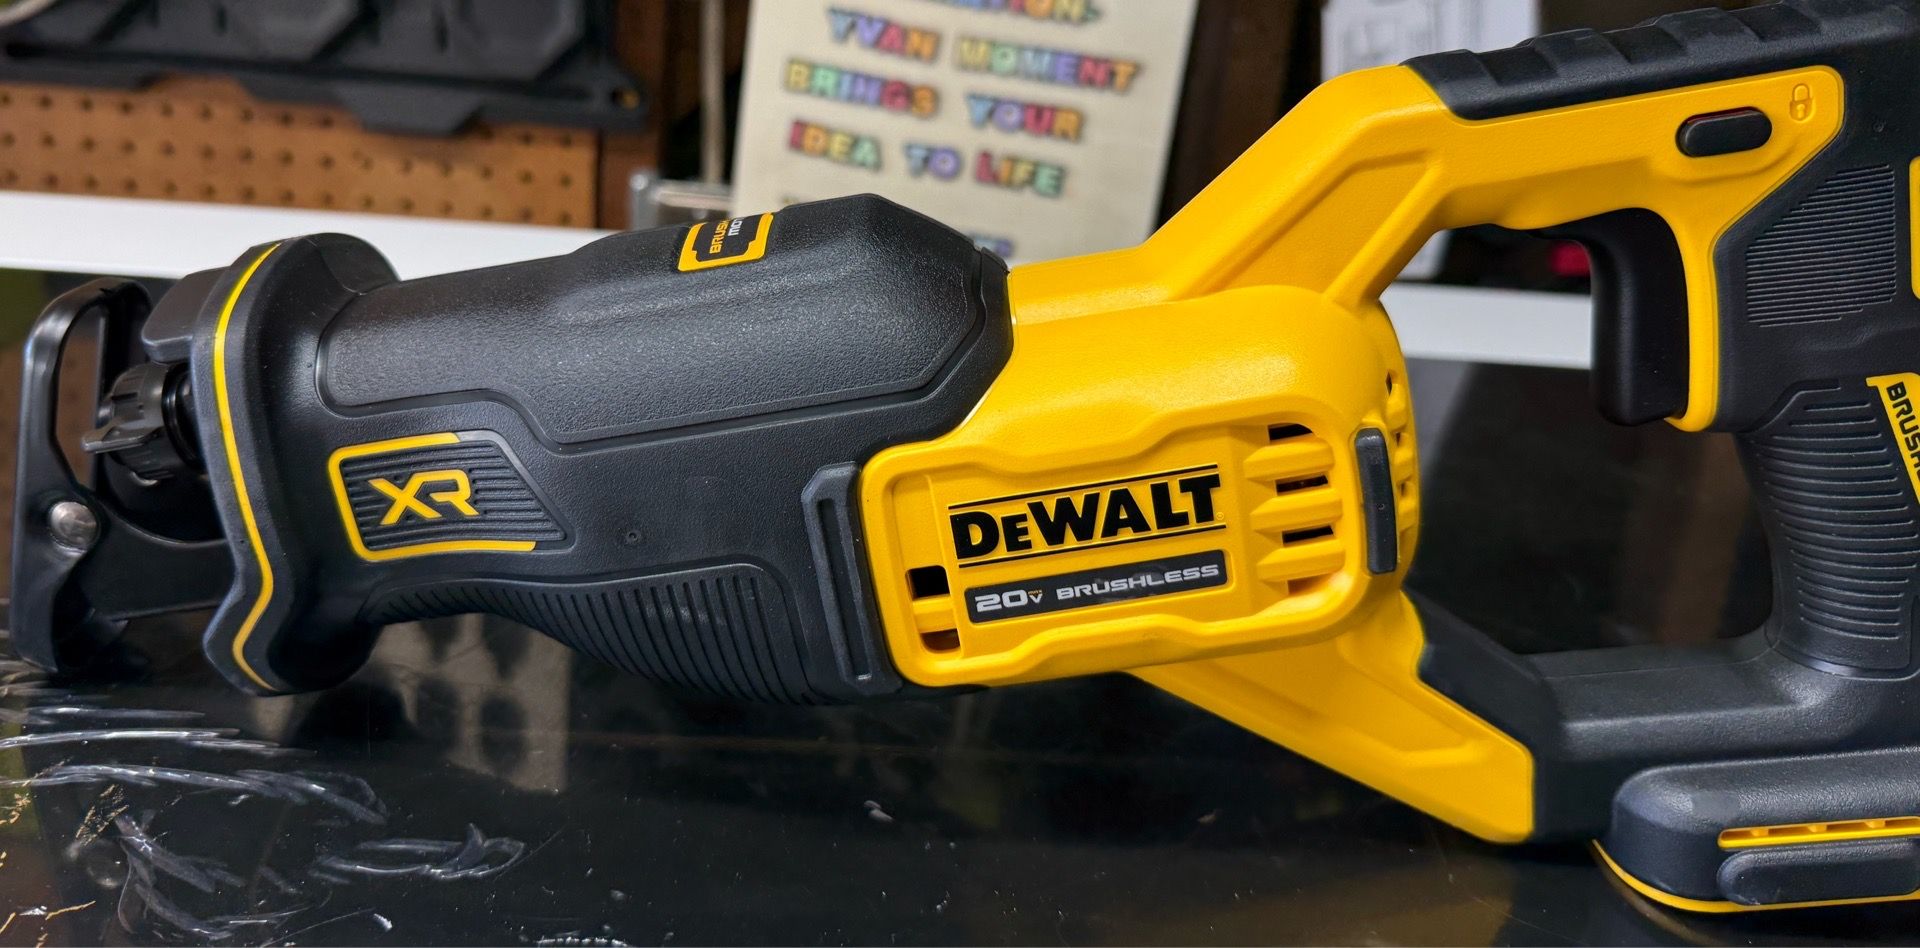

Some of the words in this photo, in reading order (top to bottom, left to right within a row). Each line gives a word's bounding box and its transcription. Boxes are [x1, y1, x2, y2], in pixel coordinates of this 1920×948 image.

[955, 36, 1141, 93] MOMENT
[785, 58, 939, 118] BRINGS
[965, 93, 1086, 142] YOUR
[788, 119, 881, 170] IDEA
[905, 143, 960, 180] TO
[975, 150, 1066, 197] LIFE
[368, 469, 479, 526] XR
[1056, 563, 1220, 601] BRUSHLESS
